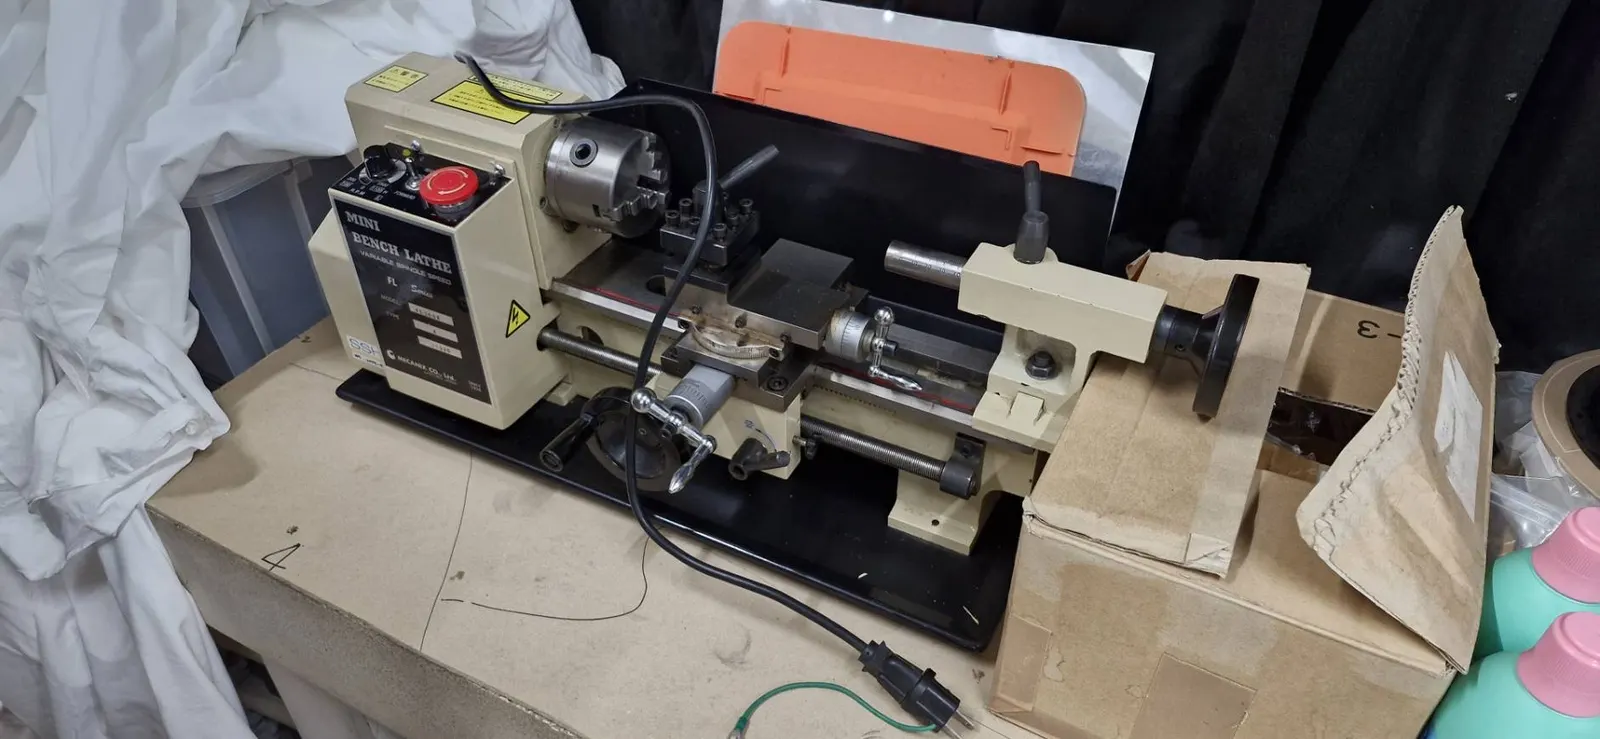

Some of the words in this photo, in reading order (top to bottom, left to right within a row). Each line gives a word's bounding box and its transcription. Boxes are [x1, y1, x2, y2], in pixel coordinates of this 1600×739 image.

[345, 211, 380, 232] MINI
[351, 231, 400, 256] BENCH
[403, 248, 452, 274] LATHE
[387, 276, 398, 287] FL
[427, 271, 452, 285] SPEED
[261, 543, 301, 571] 4
